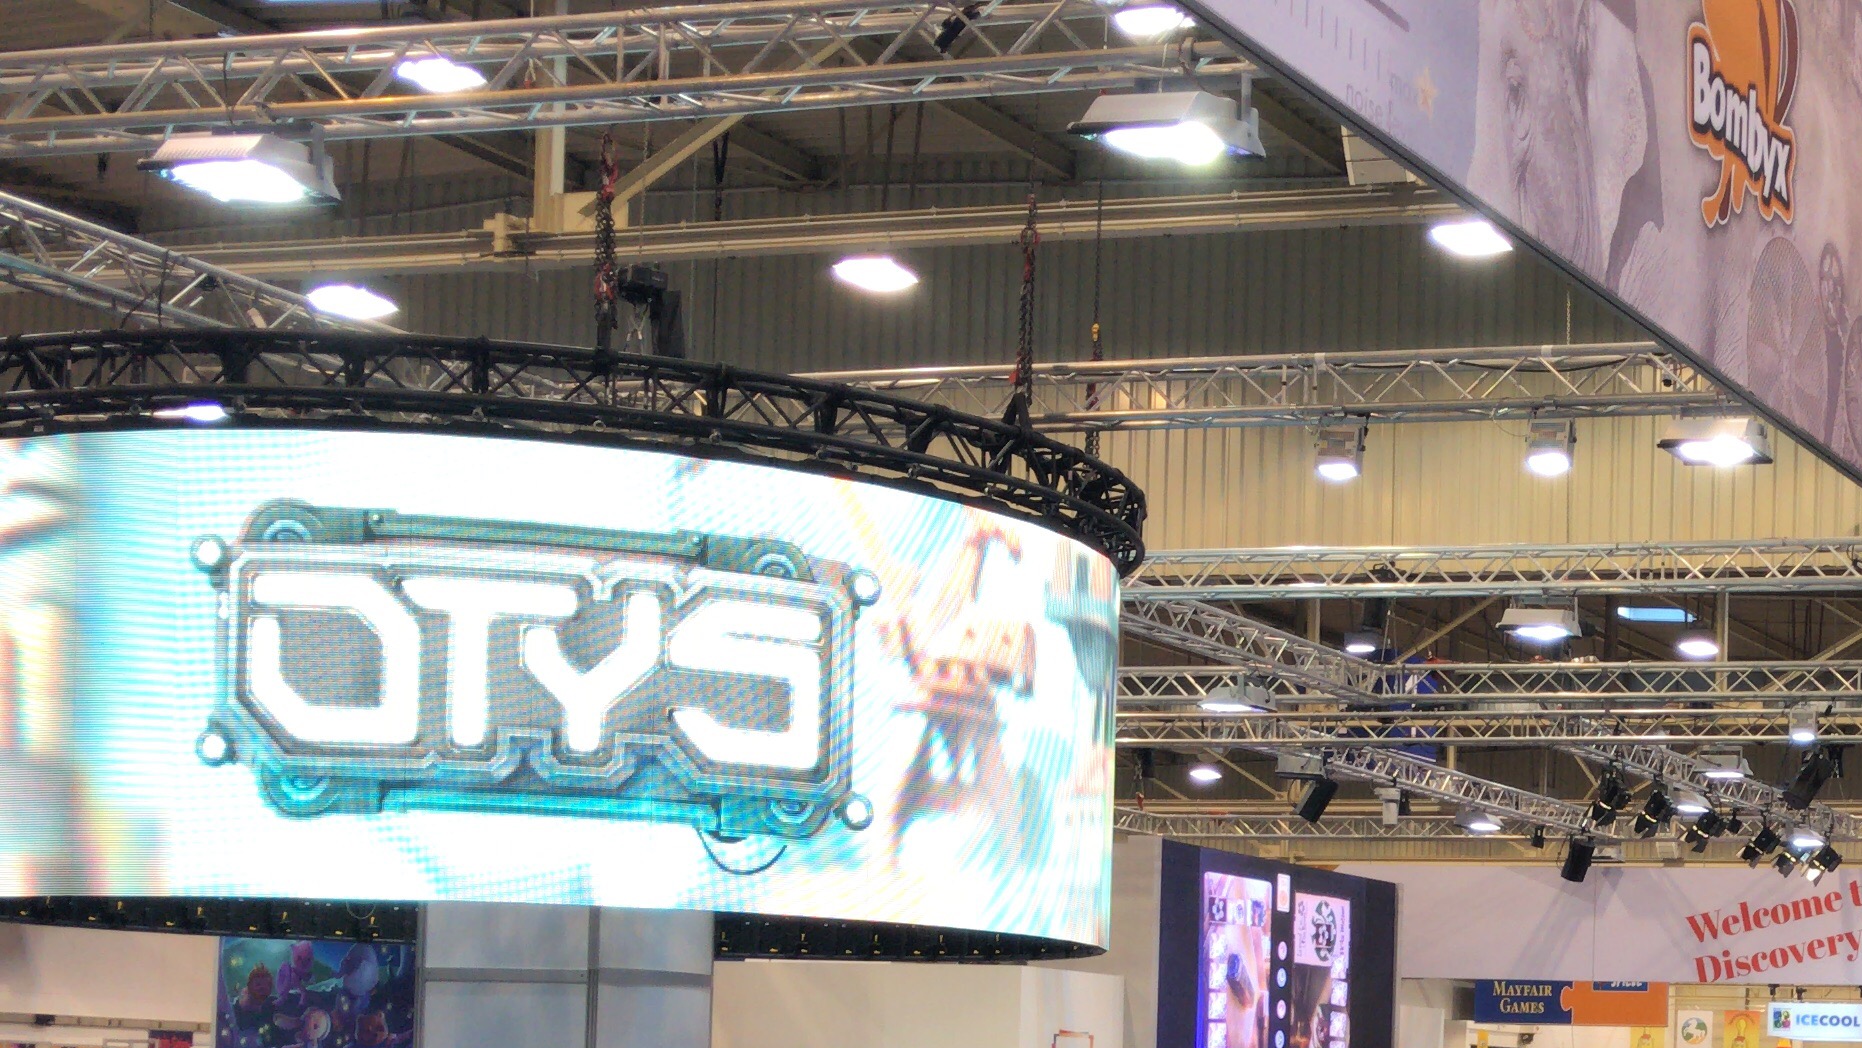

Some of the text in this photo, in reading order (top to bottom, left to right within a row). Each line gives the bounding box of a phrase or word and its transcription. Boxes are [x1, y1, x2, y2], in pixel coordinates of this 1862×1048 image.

[1693, 41, 1790, 201] Bombyx
[1686, 891, 1843, 943] Welcome
[1693, 929, 1862, 983] Discovery
[1796, 1014, 1861, 1027] ICECOOL
